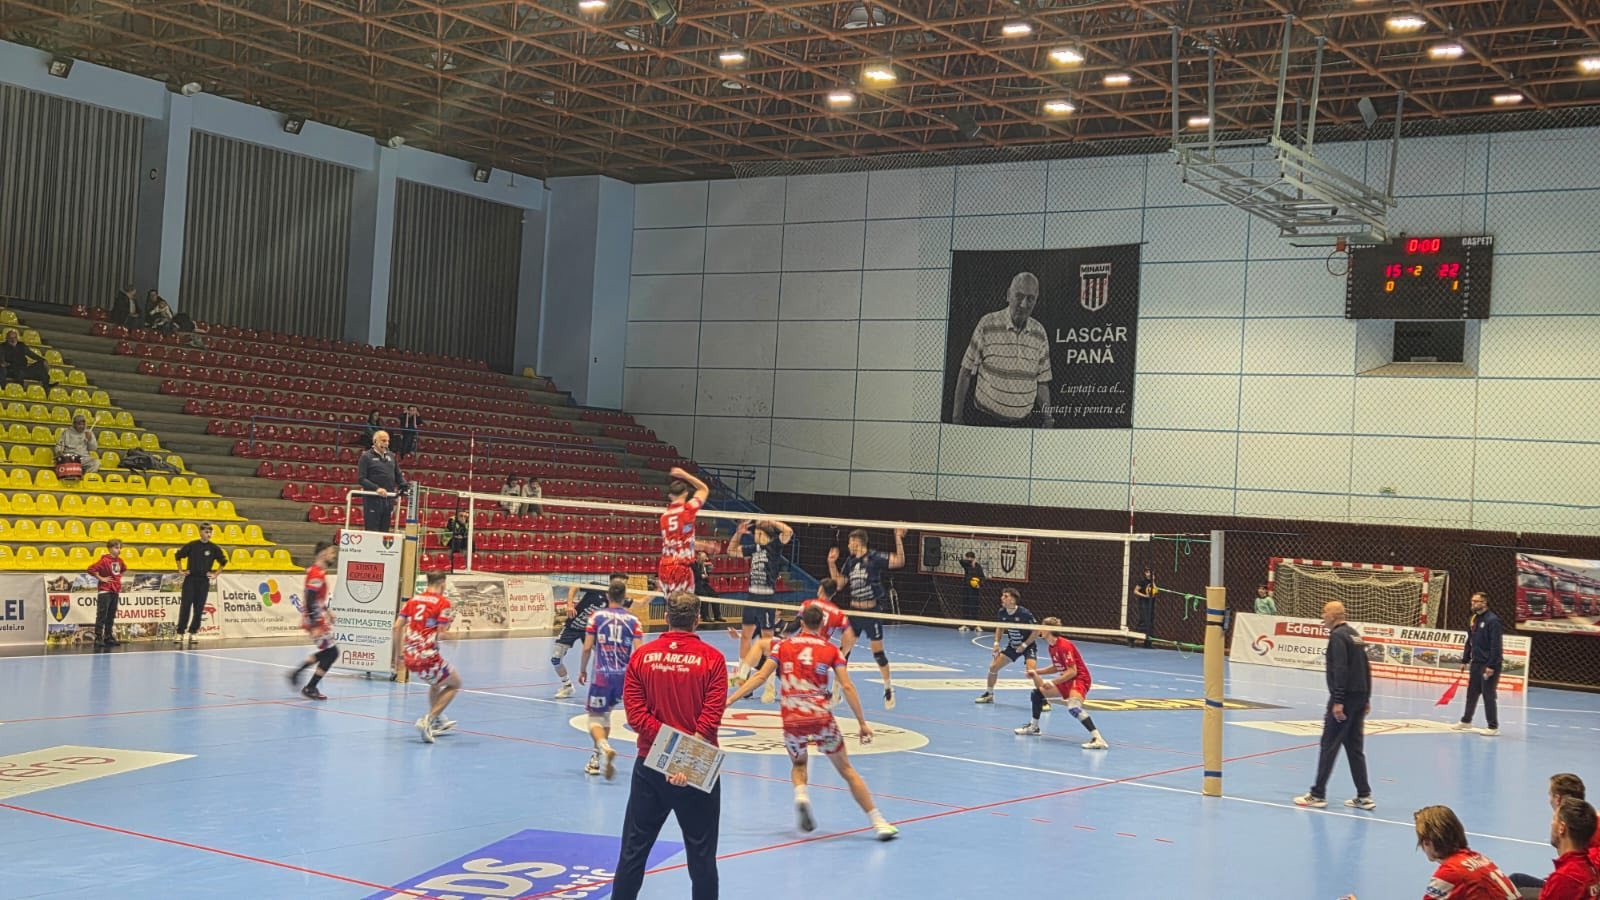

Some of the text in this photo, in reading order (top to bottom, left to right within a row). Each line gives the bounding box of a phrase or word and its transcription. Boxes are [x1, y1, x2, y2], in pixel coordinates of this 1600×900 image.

[1385, 264, 1460, 277] 15 2 22
[1385, 280, 1459, 292] 0 1
[1056, 323, 1128, 343] LASCĂR
[1066, 344, 1114, 365] PANĂ
[668, 515, 679, 531] 5
[223, 590, 257, 601] Loteria
[509, 593, 528, 601] Avem
[414, 604, 426, 620] 2
[510, 603, 518, 612] de
[1286, 622, 1331, 636] Edenia
[1400, 629, 1451, 642] RENAROM
[663, 653, 702, 666] ARCADA
[797, 646, 814, 666] 4
